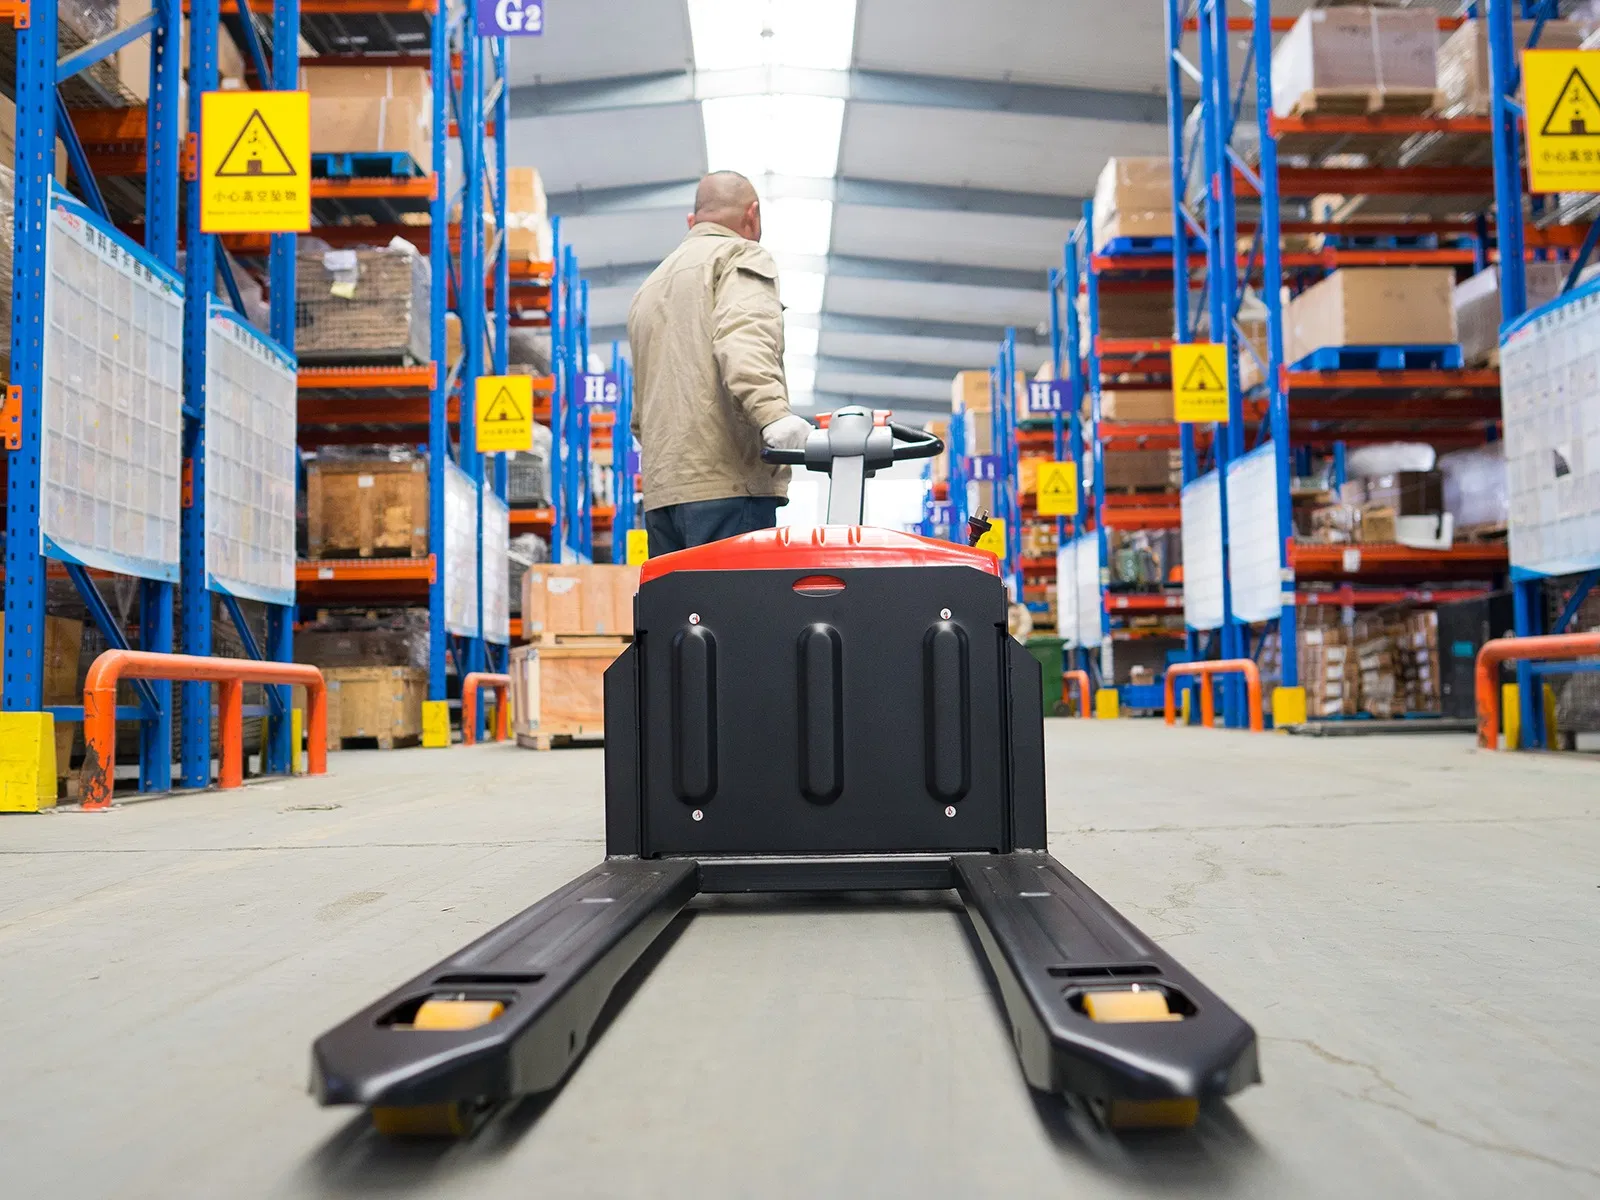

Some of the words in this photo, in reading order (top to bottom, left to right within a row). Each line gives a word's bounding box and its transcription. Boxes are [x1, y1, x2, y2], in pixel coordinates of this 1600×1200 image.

[495, 0, 541, 31] G2
[1540, 149, 1600, 164] 小心高空
[213, 188, 297, 203] 小心高空坠物
[584, 375, 617, 402] H2
[1030, 382, 1061, 410] H1
